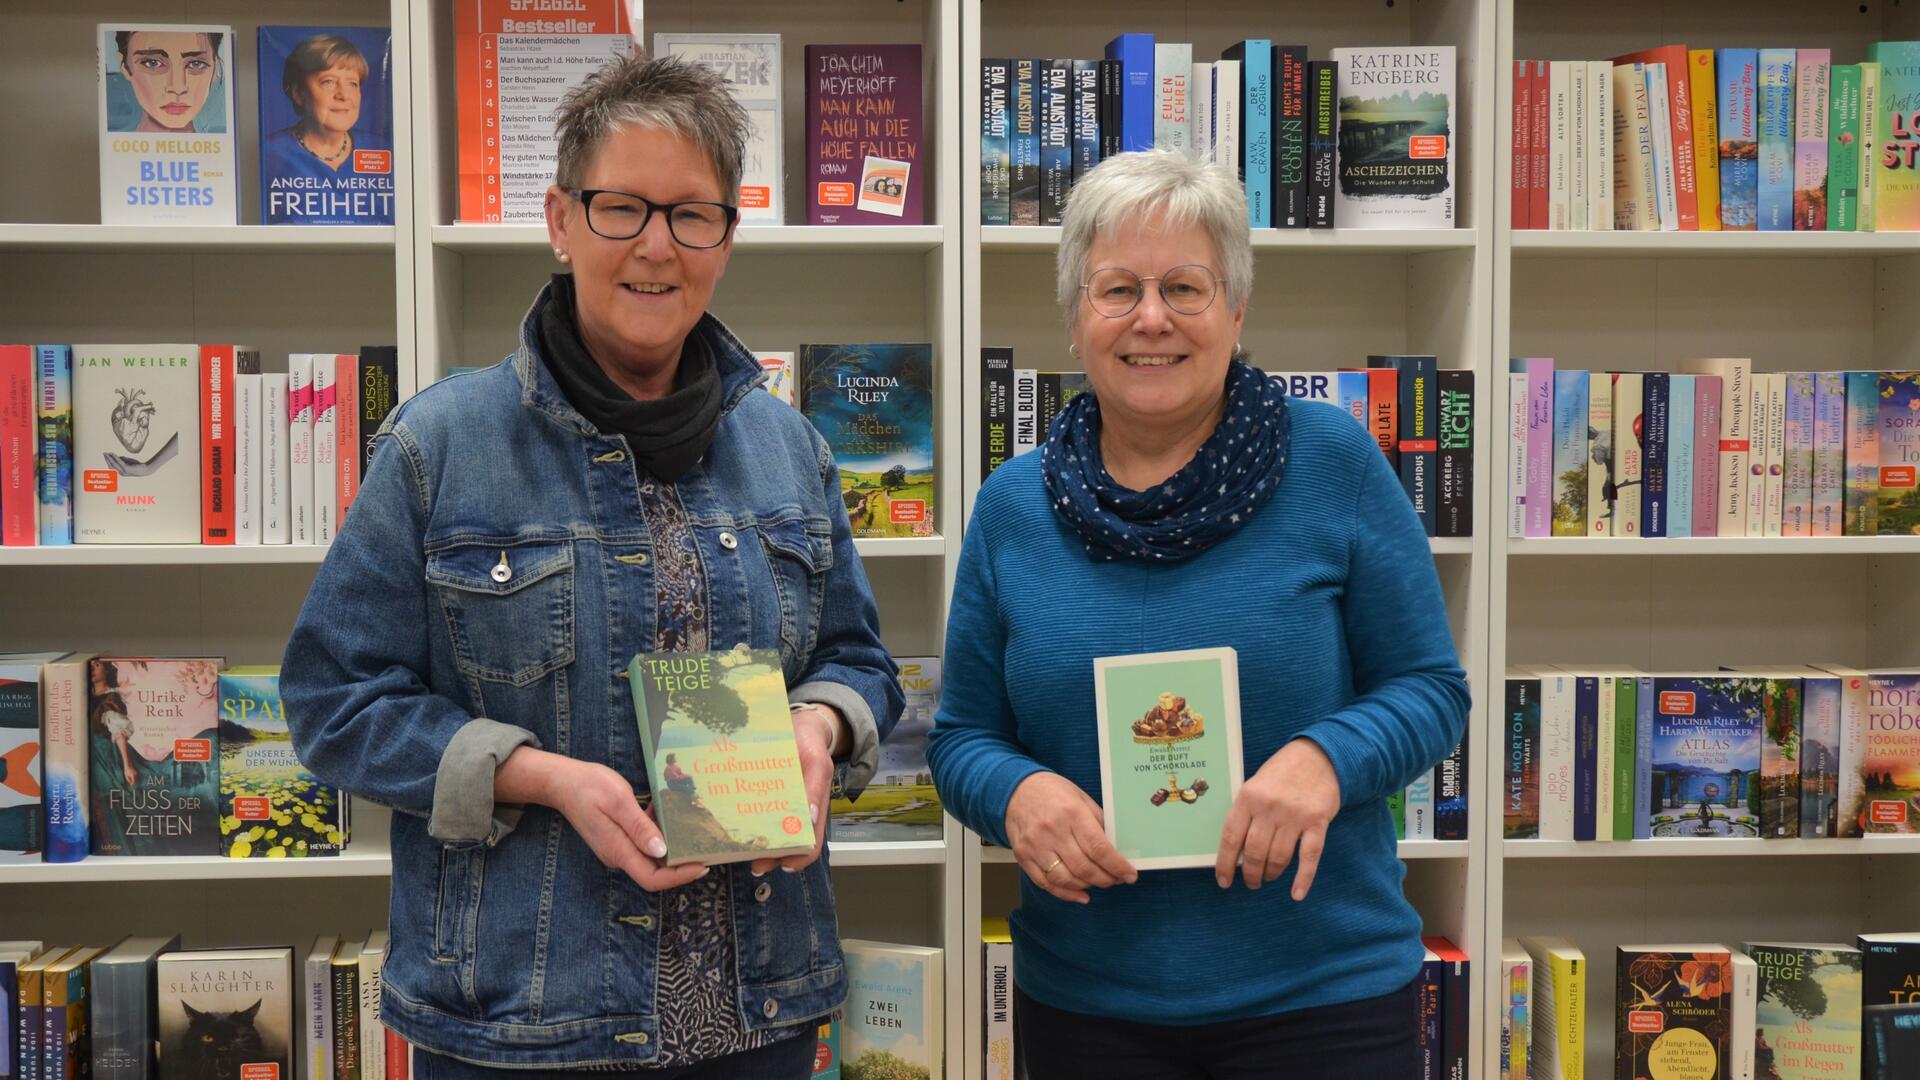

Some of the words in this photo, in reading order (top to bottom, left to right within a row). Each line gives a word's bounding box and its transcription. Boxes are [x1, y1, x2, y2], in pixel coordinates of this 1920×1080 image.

[511, 0, 586, 10] SPIEGEL
[503, 19, 595, 32] Bestseller
[820, 56, 883, 72] JOACHIM
[1019, 60, 1032, 80] EVA
[1284, 54, 1292, 79] RUHT
[1352, 54, 1439, 68] KATRINE
[515, 76, 565, 84] Buchspazierer
[991, 66, 1005, 85] EVA
[1051, 69, 1065, 90] EVA
[1082, 70, 1095, 89] EVA
[1293, 62, 1302, 94] IMMER
[1352, 71, 1439, 85] ENGBERG
[820, 77, 896, 95] MEYERHOFF
[1258, 74, 1266, 116] ZÖGLING
[820, 100, 850, 114] MAN
[856, 99, 894, 115] KANN
[1163, 78, 1172, 120] EULEN
[1175, 75, 1185, 123] SCHREI
[1284, 83, 1292, 116] NICHTS
[1293, 98, 1302, 116] FÜR
[1319, 69, 1331, 135] ANGSTTREIBER
[1635, 84, 1645, 119] PFAU
[991, 88, 1006, 137] ALMSTÄDT
[1018, 85, 1033, 135] ALMSTÄDT
[1082, 92, 1096, 141] ALMSTÄDT
[821, 121, 858, 137] AUCH
[865, 120, 879, 137] IN
[886, 120, 909, 137] DIE
[1051, 94, 1066, 147] ALMSTÄDT
[113, 140, 149, 153] COCO
[156, 140, 221, 154] MELLORS
[1639, 125, 1649, 154] DER
[503, 154, 515, 162] Hey
[820, 141, 853, 159] HÖHE
[860, 144, 915, 158] FALLEN
[1258, 131, 1267, 174] CRAVEN
[1282, 120, 1296, 184] HARLAN
[1290, 120, 1302, 183] COBEN
[140, 161, 199, 182] BLUE
[820, 163, 847, 174] ROMAN
[1315, 158, 1323, 181] PAUL
[1345, 165, 1444, 176] ASCHEZEICHEN
[271, 178, 331, 189] ANGELA
[337, 178, 393, 189] MERKEL
[127, 187, 214, 206] SISTERS
[271, 192, 394, 216] FREIHEIT
[80, 358, 111, 367] JAN
[124, 358, 188, 367] WEILER
[210, 357, 221, 389] MÖRDER
[838, 374, 898, 388] LUCINDA
[366, 366, 376, 419] POISON
[848, 390, 888, 404] RILEY
[1018, 378, 1033, 410] BLOOD
[212, 392, 221, 420] FINDEN
[1379, 403, 1390, 429] LATE
[1416, 378, 1424, 436] KREUZVERHÖR
[1731, 394, 1740, 436] Pineapple
[1018, 413, 1033, 444] FINAL
[1441, 390, 1451, 449] SCHWARZ
[1452, 391, 1470, 448] LICHT
[212, 423, 221, 439] WIR
[990, 423, 1004, 451] ERDE
[213, 447, 221, 474] OSMAN
[1444, 456, 1452, 504] LÄCKBERG
[1730, 455, 1739, 492] Jackson
[116, 496, 156, 504] MUNK
[213, 478, 222, 512] RICHARD
[1416, 492, 1424, 513] JENS
[649, 658, 710, 674] TRUDE
[653, 675, 710, 692] TEIGE
[138, 691, 186, 703] Ulrike
[146, 705, 184, 717] Renk
[1672, 717, 1712, 725] LUCINDA
[1714, 717, 1740, 725] RILEY
[1660, 726, 1691, 736] HARRY
[1697, 725, 1752, 736] WHITTAKER
[710, 736, 738, 752] Als
[1513, 712, 1523, 773] MORTON
[1681, 739, 1730, 750] ATLAS
[246, 750, 285, 758] UNSERE
[246, 759, 266, 767] DER
[1168, 753, 1188, 761] DUFT
[692, 755, 794, 776] Großmutter
[1134, 763, 1150, 772] VON
[1153, 761, 1206, 771] SCHOKOLADE
[147, 776, 164, 785] AM
[707, 781, 732, 796] im
[735, 776, 785, 794] Regen
[1443, 759, 1454, 797] OKTOPUS
[63, 783, 73, 824] Recchia
[110, 789, 171, 809] FLUSS
[178, 798, 200, 808] DER
[1512, 777, 1522, 810] KATE
[51, 784, 60, 825] Roberta
[736, 799, 789, 817] tanzte
[125, 815, 192, 835] ZEITEN
[1758, 952, 1804, 966] TRUDE
[190, 971, 253, 982] KARIN
[1759, 966, 1801, 980] TEIGE
[170, 982, 274, 993] SLAUGHTER
[315, 982, 323, 1011] MANN
[994, 965, 1006, 1009] UNTERHOLZ
[869, 1001, 898, 1013] ZWEI
[994, 1012, 1006, 1022] IM
[1569, 983, 1577, 1043] ECHTZEITALTER
[1672, 1008, 1716, 1016] SCHRÖDER
[315, 1015, 323, 1039] MEIN
[866, 1016, 902, 1028] LEBEN
[1790, 1022, 1812, 1032] Als
[1776, 1038, 1855, 1054] Großmutter
[1784, 1056, 1801, 1067] im
[1804, 1056, 1843, 1070] Regen
